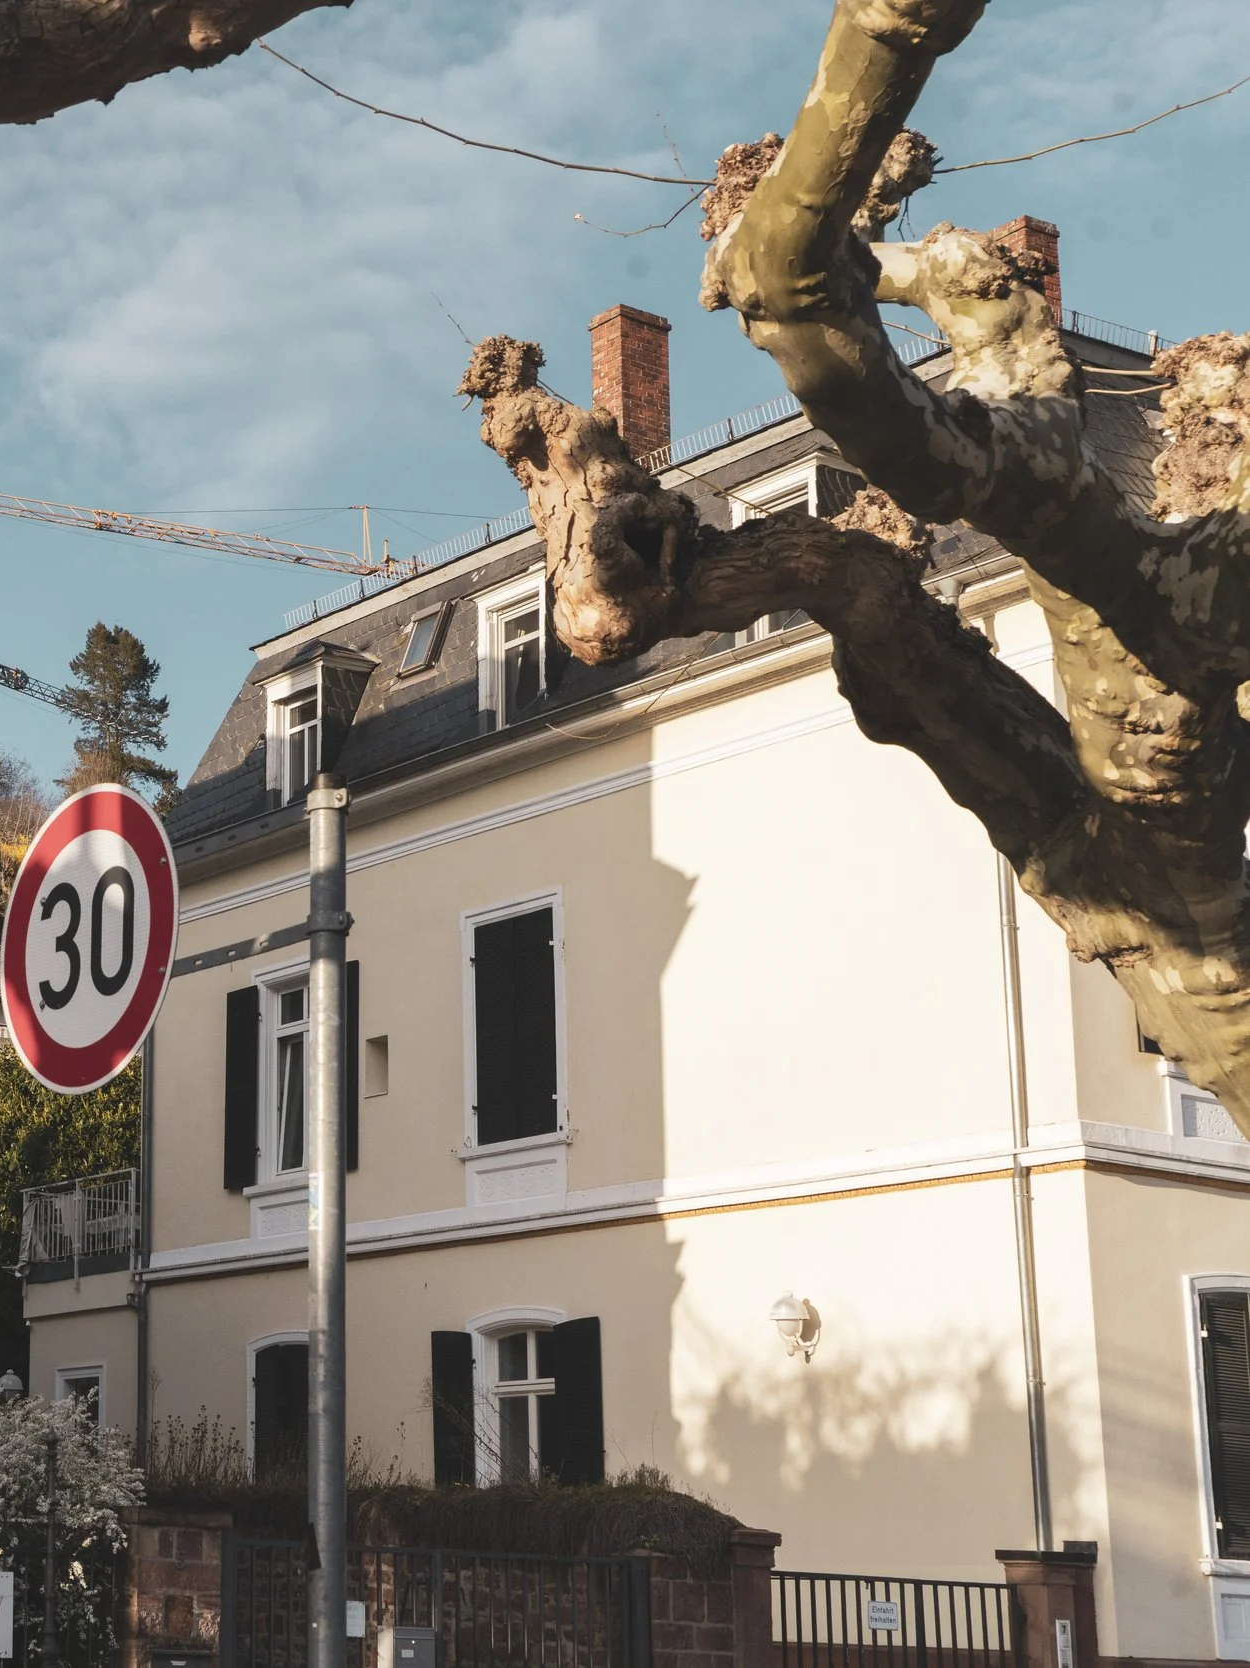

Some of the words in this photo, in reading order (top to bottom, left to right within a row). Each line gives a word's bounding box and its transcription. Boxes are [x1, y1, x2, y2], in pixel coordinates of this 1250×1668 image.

[39, 865, 135, 1010] 30
[871, 1605, 895, 1614] Einfahrt
[870, 1615, 897, 1624] freihalten
